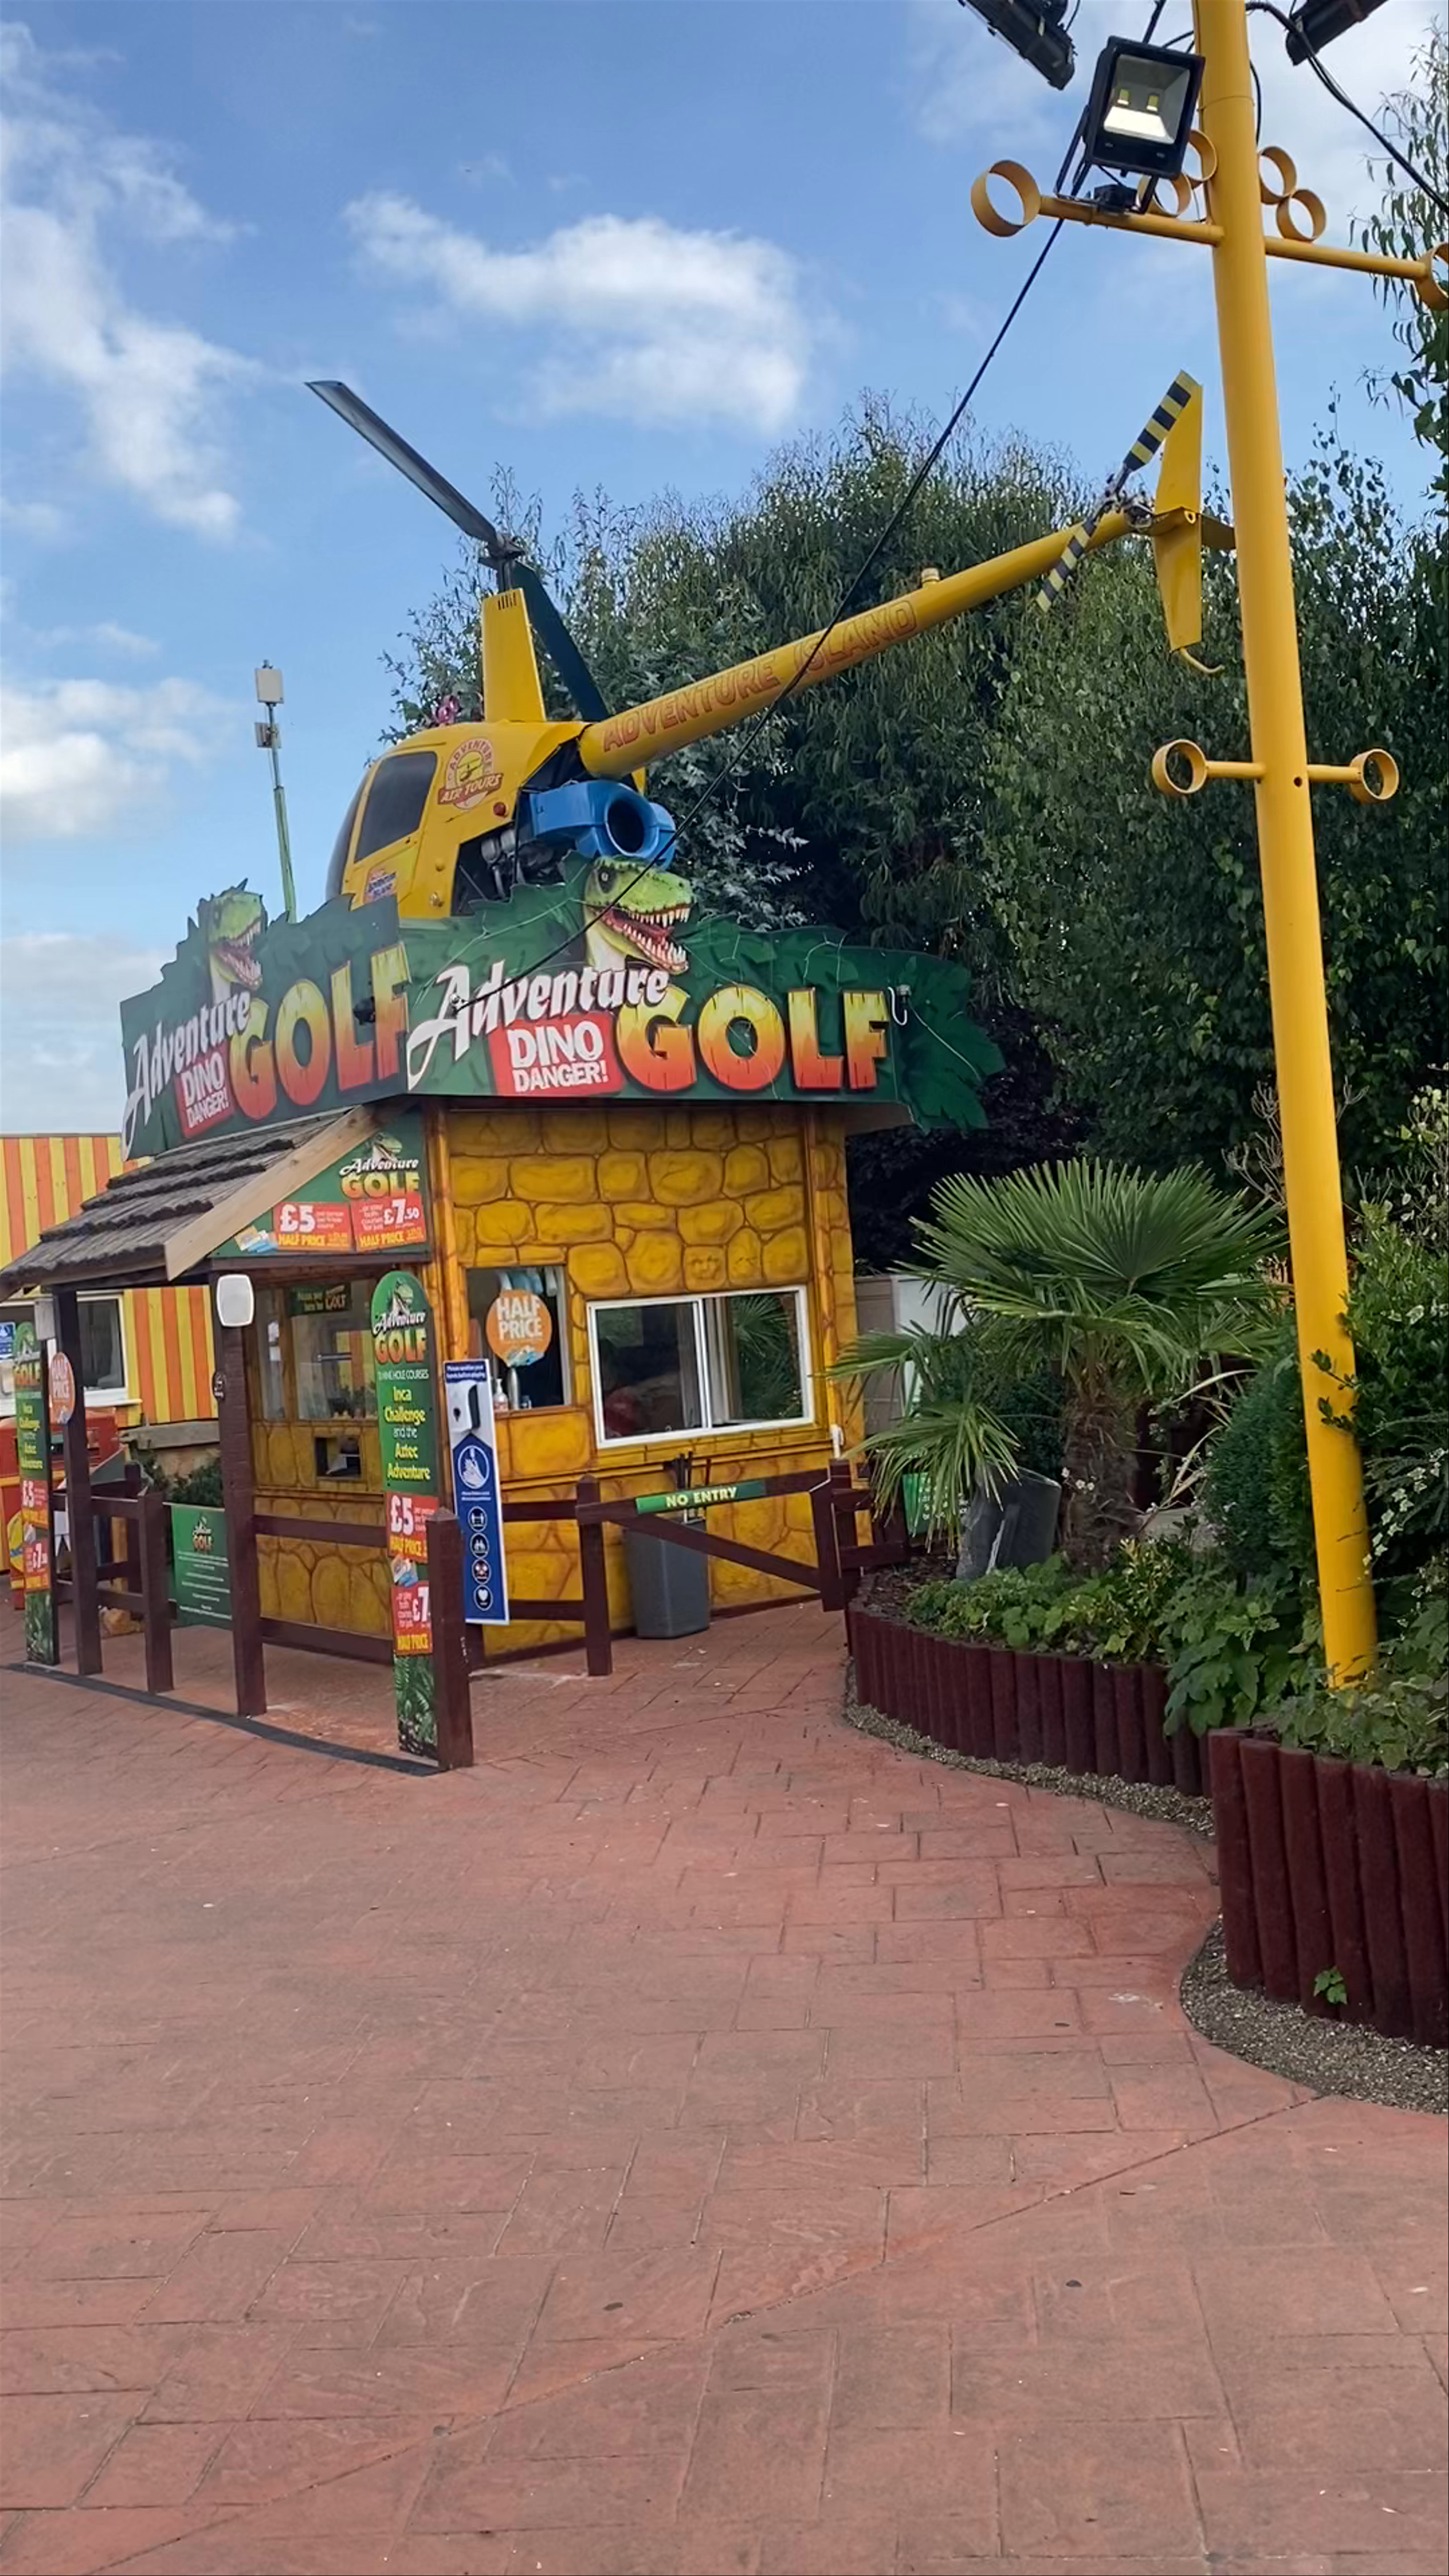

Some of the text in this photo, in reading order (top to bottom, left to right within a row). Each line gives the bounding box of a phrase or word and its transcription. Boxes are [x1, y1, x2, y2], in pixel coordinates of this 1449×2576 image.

[603, 600, 917, 752] ADVENTURE ISLAND
[440, 774, 502, 803] AIR TOURS
[229, 942, 412, 1121] GOLF
[406, 960, 670, 1091] Adventure
[616, 984, 889, 1091] GOLF
[506, 1021, 604, 1069] DINO
[121, 990, 251, 1161] Adventure
[180, 1051, 225, 1107] DINO
[512, 1060, 609, 1092] DANGER!
[186, 1090, 229, 1128] DANGER!
[339, 1157, 419, 1176] Adventure
[341, 1171, 420, 1198] GOLF
[280, 1203, 316, 1233] £5
[384, 1198, 420, 1225] £7.50
[278, 1234, 299, 1245] HALF
[301, 1234, 325, 1245] PRICE
[360, 1234, 379, 1247] HALF
[381, 1230, 404, 1244] PRICE
[497, 1296, 541, 1320] HALF
[373, 1312, 426, 1335] Adventure
[498, 1317, 543, 1341] PRICE
[375, 1327, 427, 1363] GOLF
[393, 1386, 412, 1401] Inca
[385, 1406, 426, 1426] Challenge
[395, 1442, 418, 1459] Aztec
[387, 1462, 431, 1480] Adventure
[665, 1486, 738, 1508] NO ENTRY
[391, 1495, 414, 1536] £5
[412, 1586, 431, 1622] £7.
